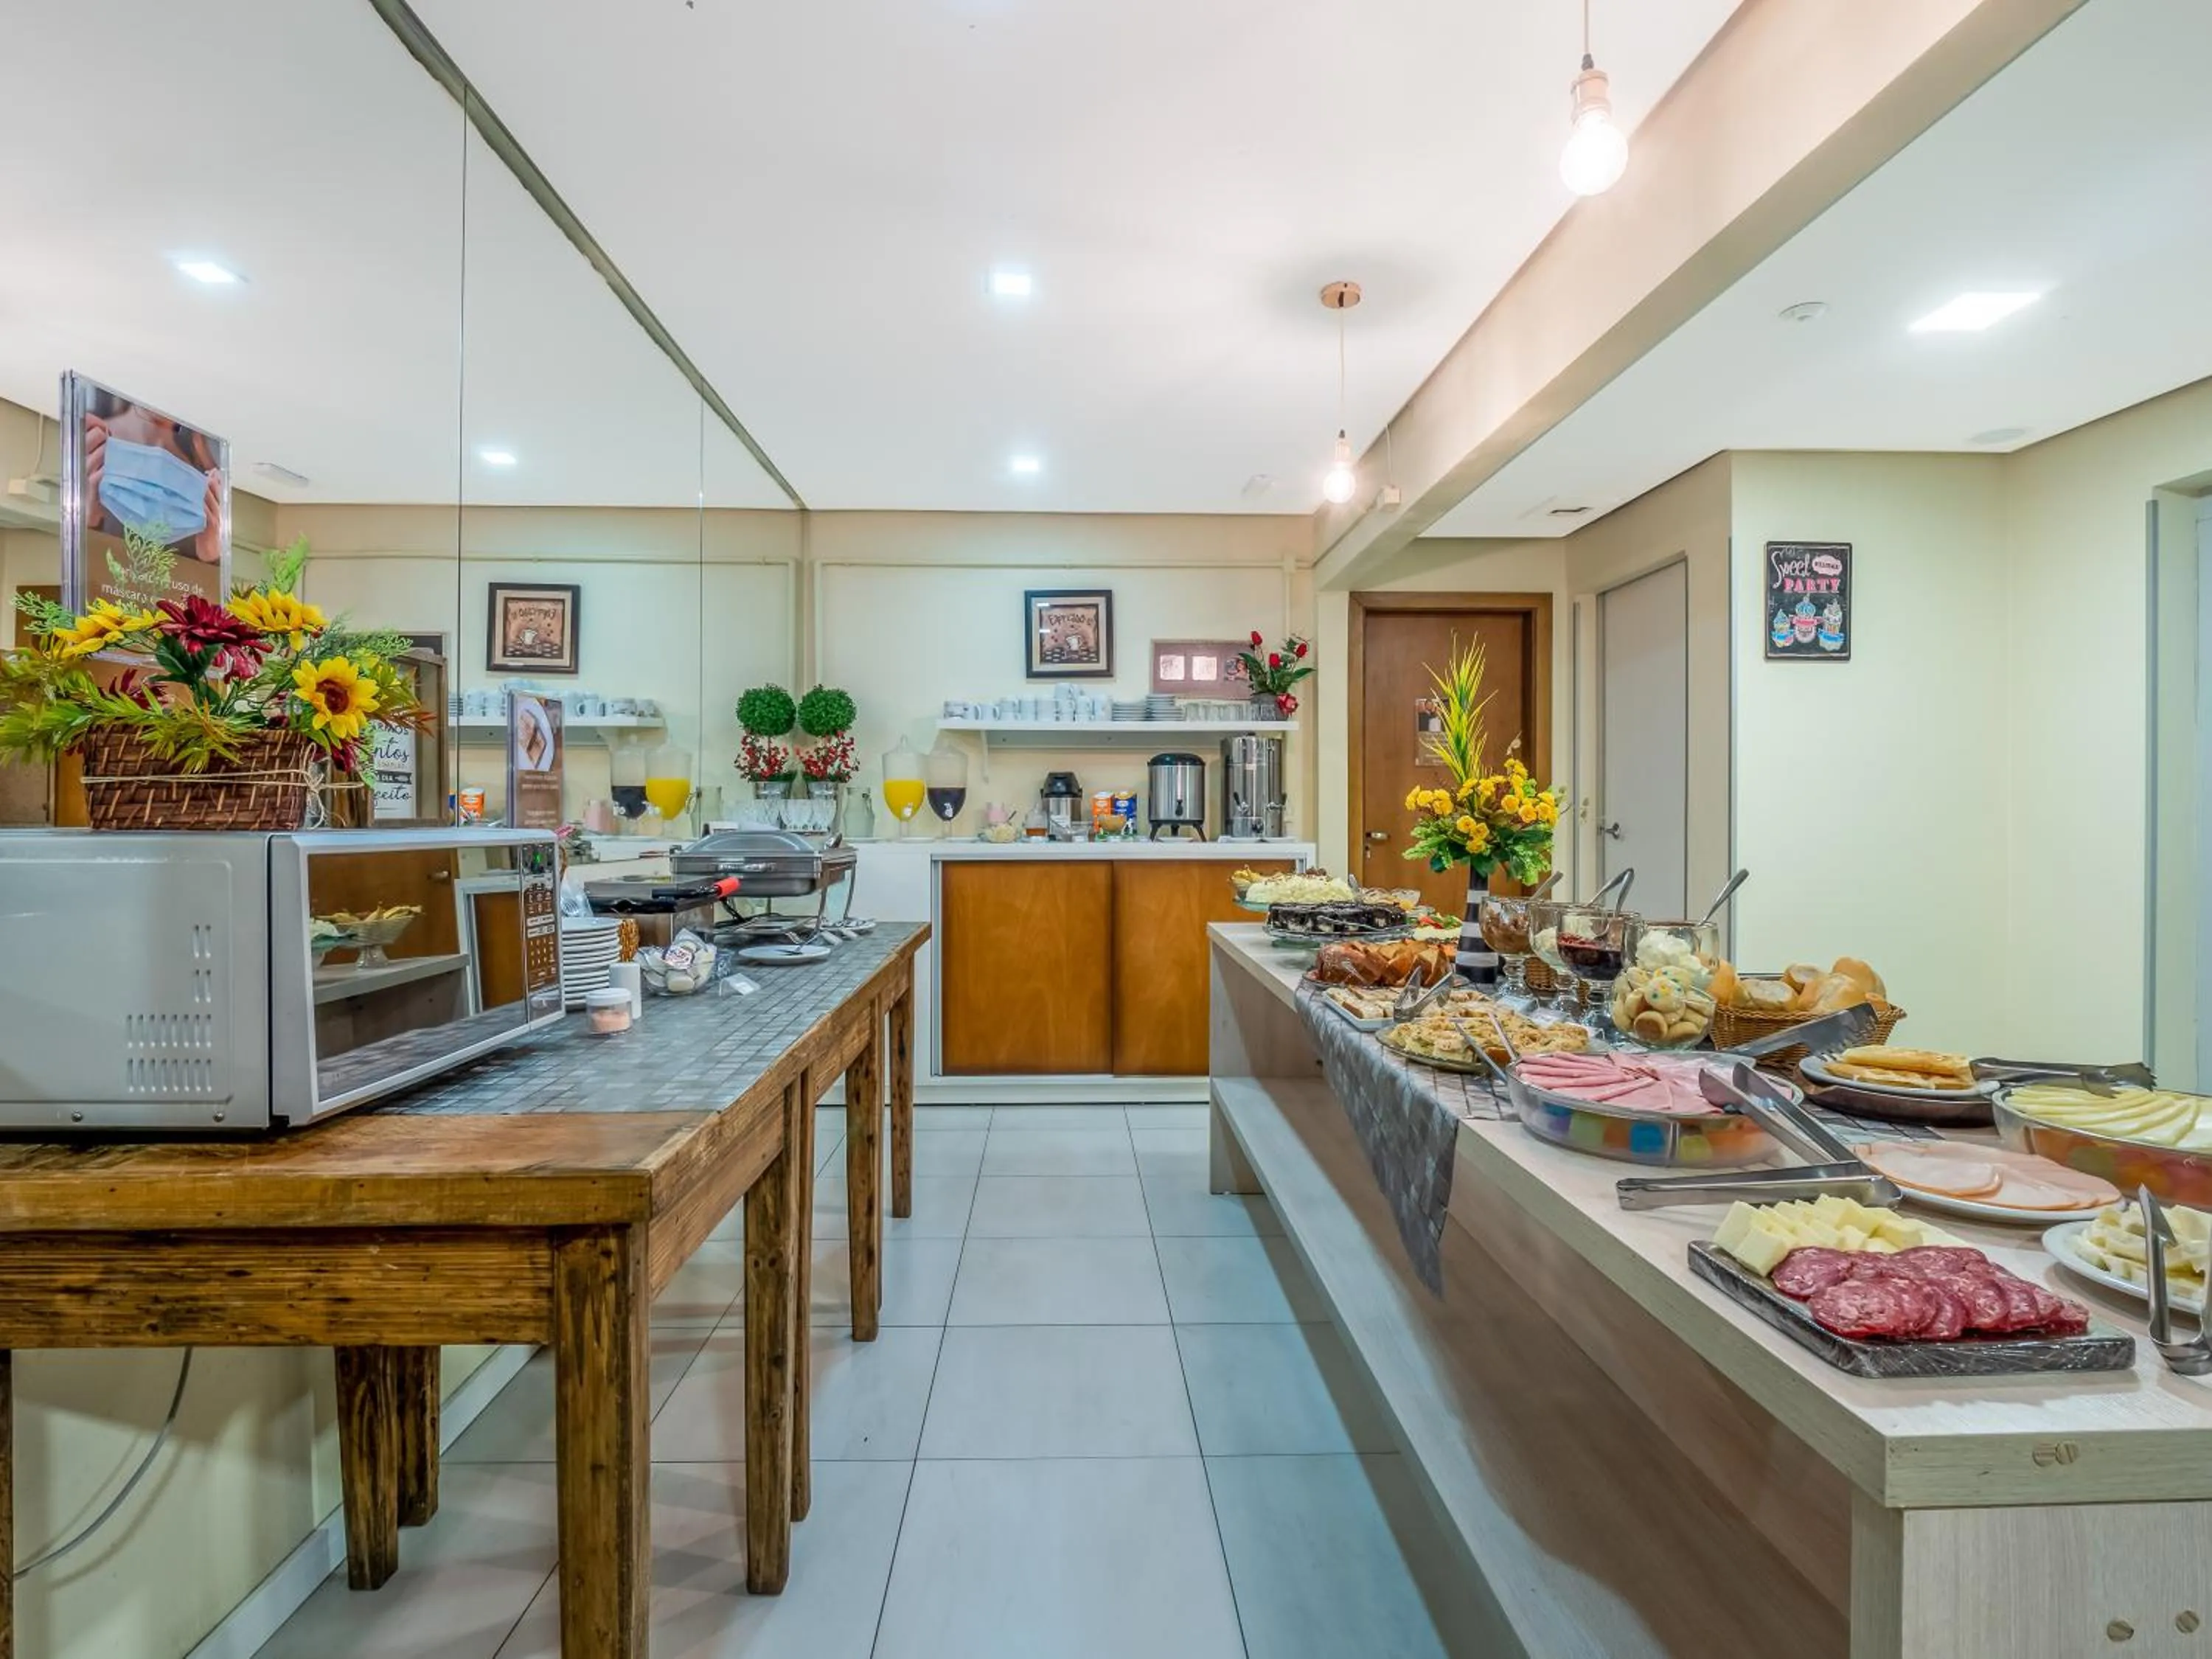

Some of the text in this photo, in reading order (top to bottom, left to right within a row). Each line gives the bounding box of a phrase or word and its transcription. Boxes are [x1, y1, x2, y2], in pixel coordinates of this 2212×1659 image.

[1770, 551, 1812, 589] Sweet
[172, 580, 205, 596] uso de
[1783, 577, 1841, 594] PARTY
[373, 737, 410, 763] ntos
